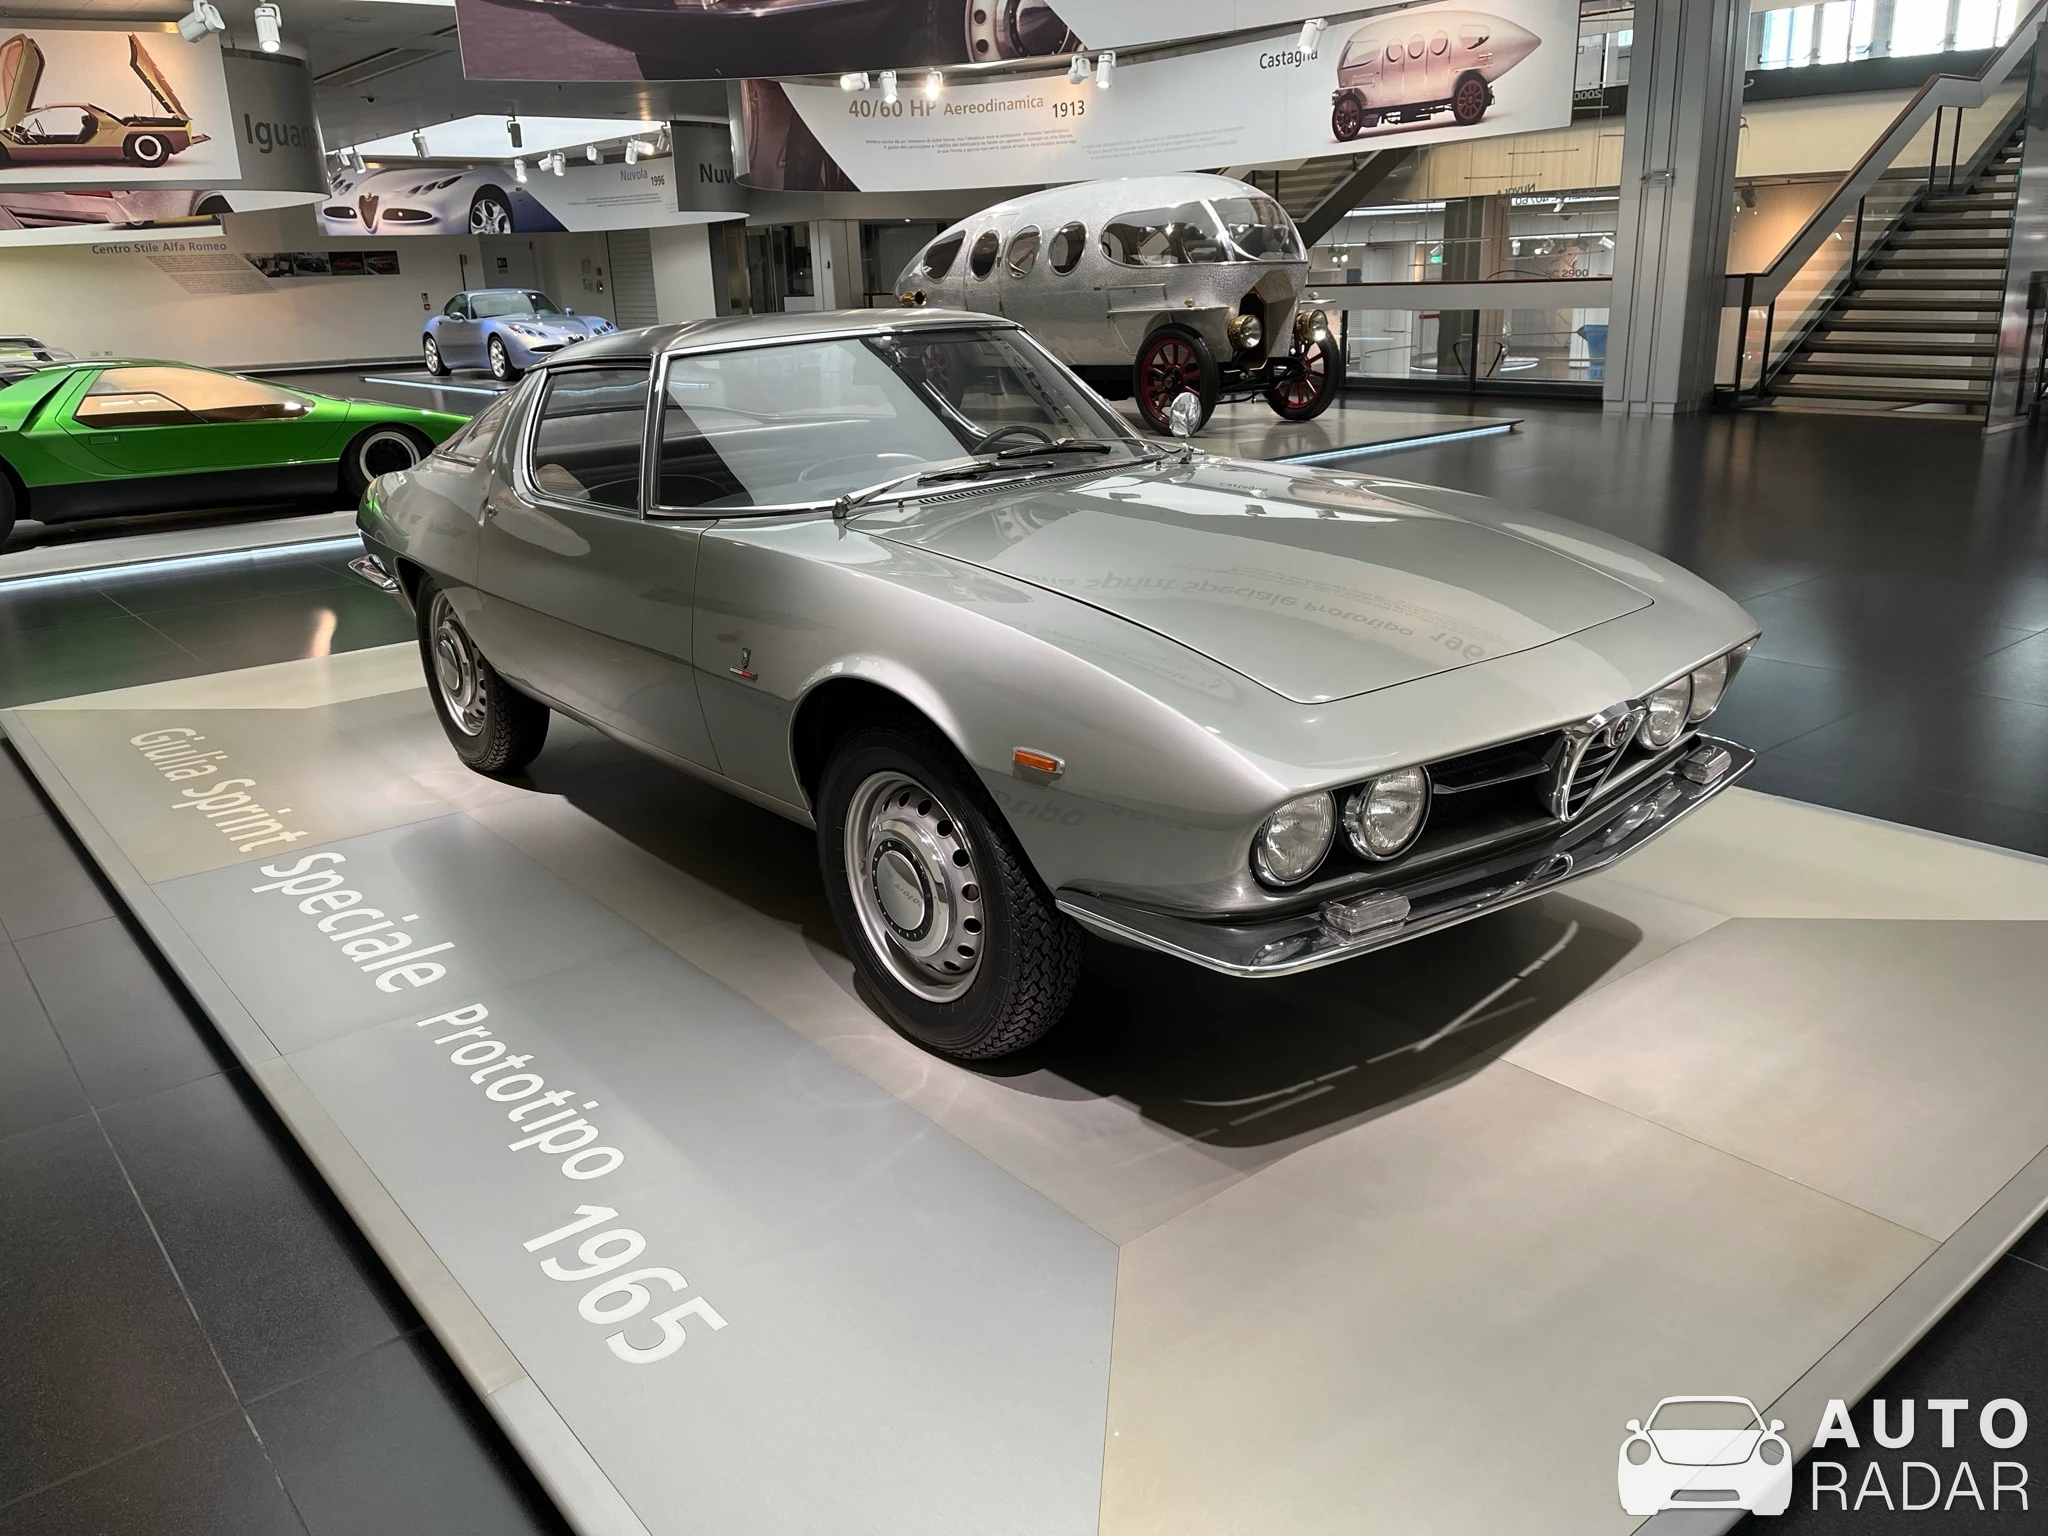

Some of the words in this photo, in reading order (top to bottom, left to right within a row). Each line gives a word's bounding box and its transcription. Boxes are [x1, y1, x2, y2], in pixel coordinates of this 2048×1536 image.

[848, 98, 903, 119] 40/60
[910, 99, 937, 118] HP
[943, 95, 1044, 116] Aereodinamica
[1052, 99, 1085, 118] 1913
[620, 168, 648, 181] Nuvola
[651, 175, 665, 186] 1996
[91, 244, 131, 255] Centro
[134, 243, 159, 254] Stile
[162, 242, 186, 252] Alfa
[189, 241, 227, 251] Romeo
[1561, 269, 1589, 278] 2900
[130, 727, 229, 782] Giulia
[171, 778, 309, 853] Sprint
[251, 851, 456, 993] Speciale
[415, 1002, 625, 1180] Prototipo
[522, 1204, 730, 1364] 1965
